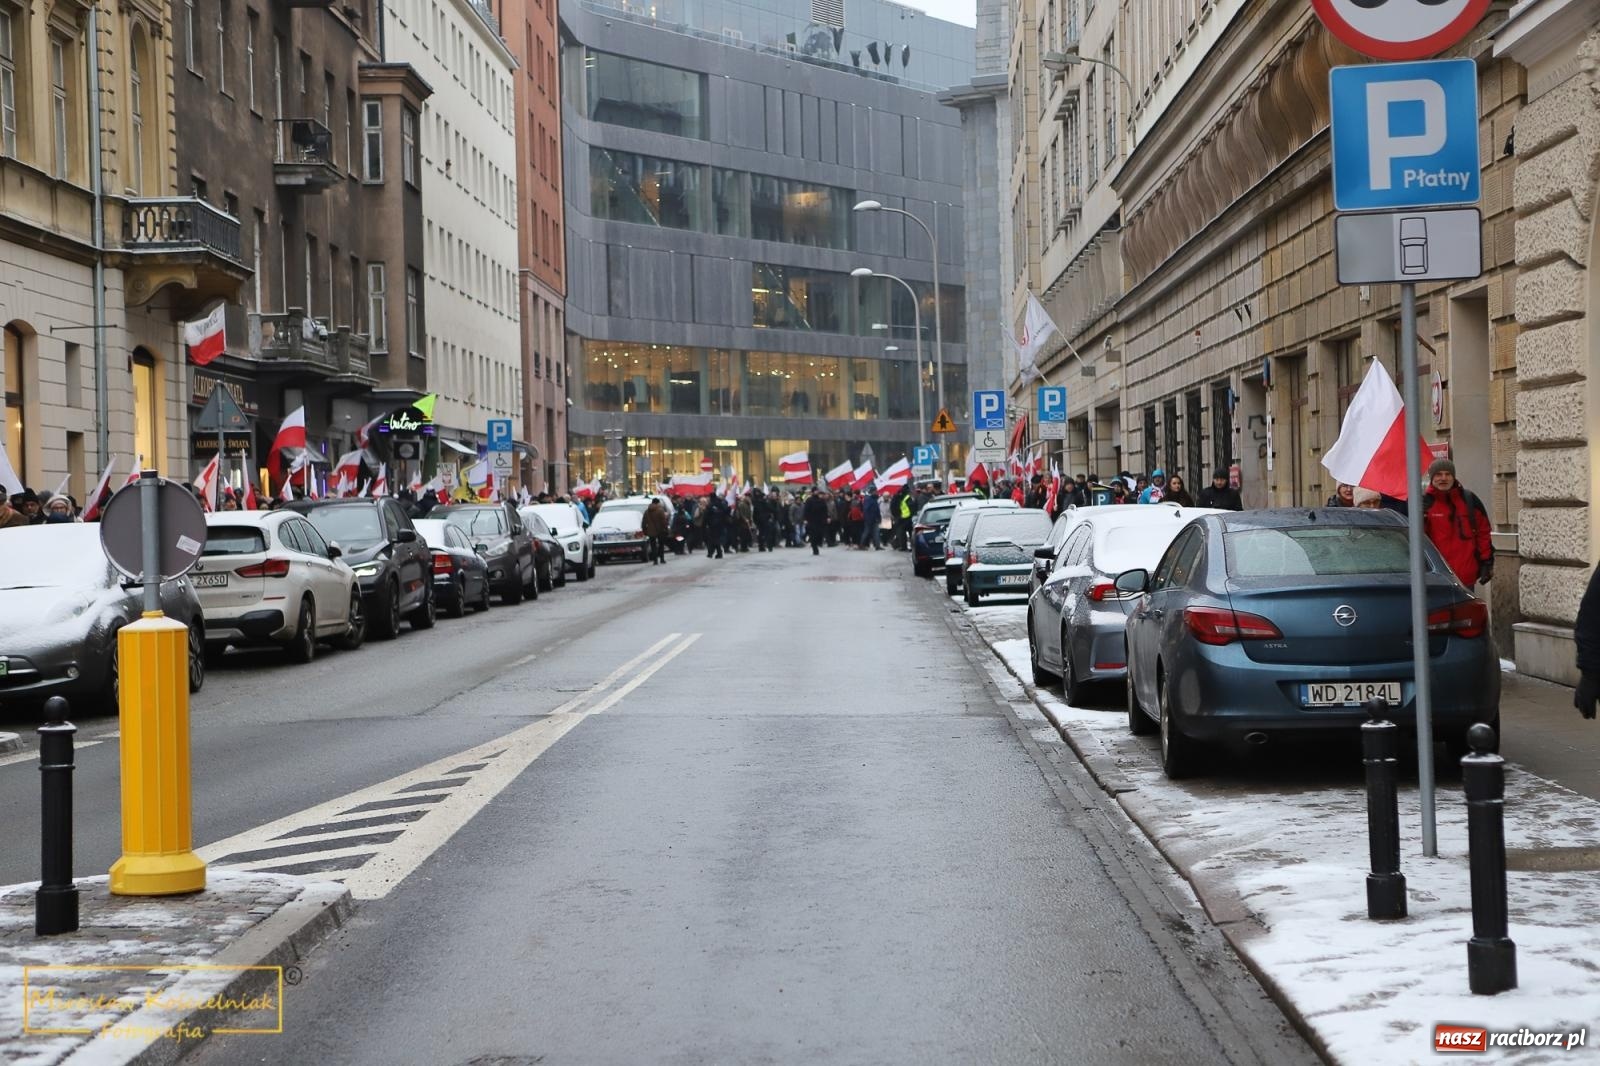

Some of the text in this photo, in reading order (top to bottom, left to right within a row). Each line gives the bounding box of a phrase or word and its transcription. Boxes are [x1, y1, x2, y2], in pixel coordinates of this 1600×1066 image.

[1366, 79, 1447, 190] P
[1403, 168, 1470, 190] Płatny
[980, 393, 999, 418] P
[1044, 389, 1061, 412] P
[492, 422, 508, 442] P
[917, 448, 929, 463] P
[1098, 494, 1106, 505] P
[1311, 685, 1337, 702] WD
[1343, 684, 1399, 701] 2184L
